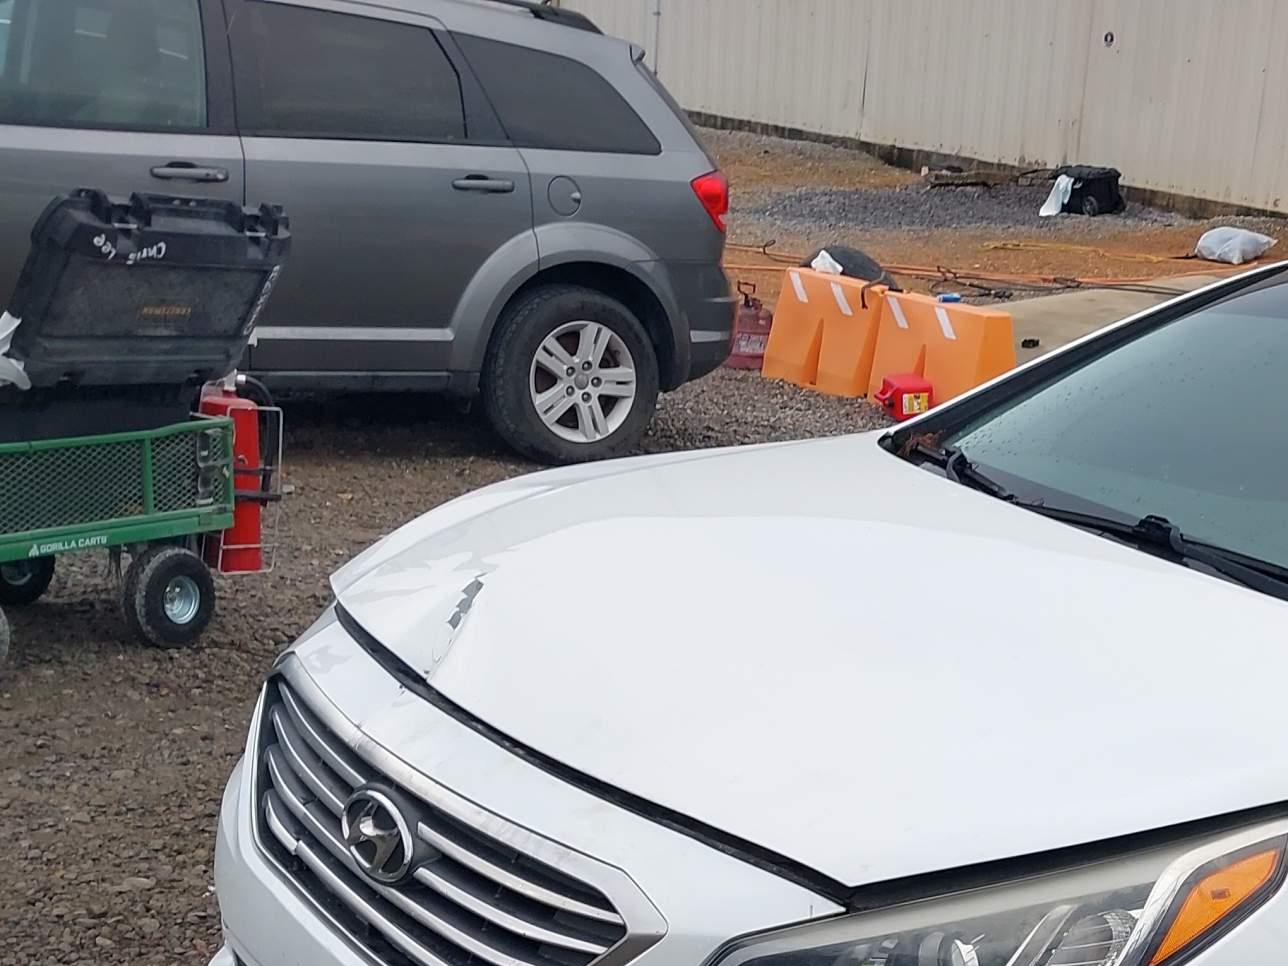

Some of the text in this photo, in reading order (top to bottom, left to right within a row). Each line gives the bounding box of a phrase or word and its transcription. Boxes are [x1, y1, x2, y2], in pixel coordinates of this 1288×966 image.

[93, 233, 167, 265] Chris Lee
[40, 540, 77, 553] GORILLA
